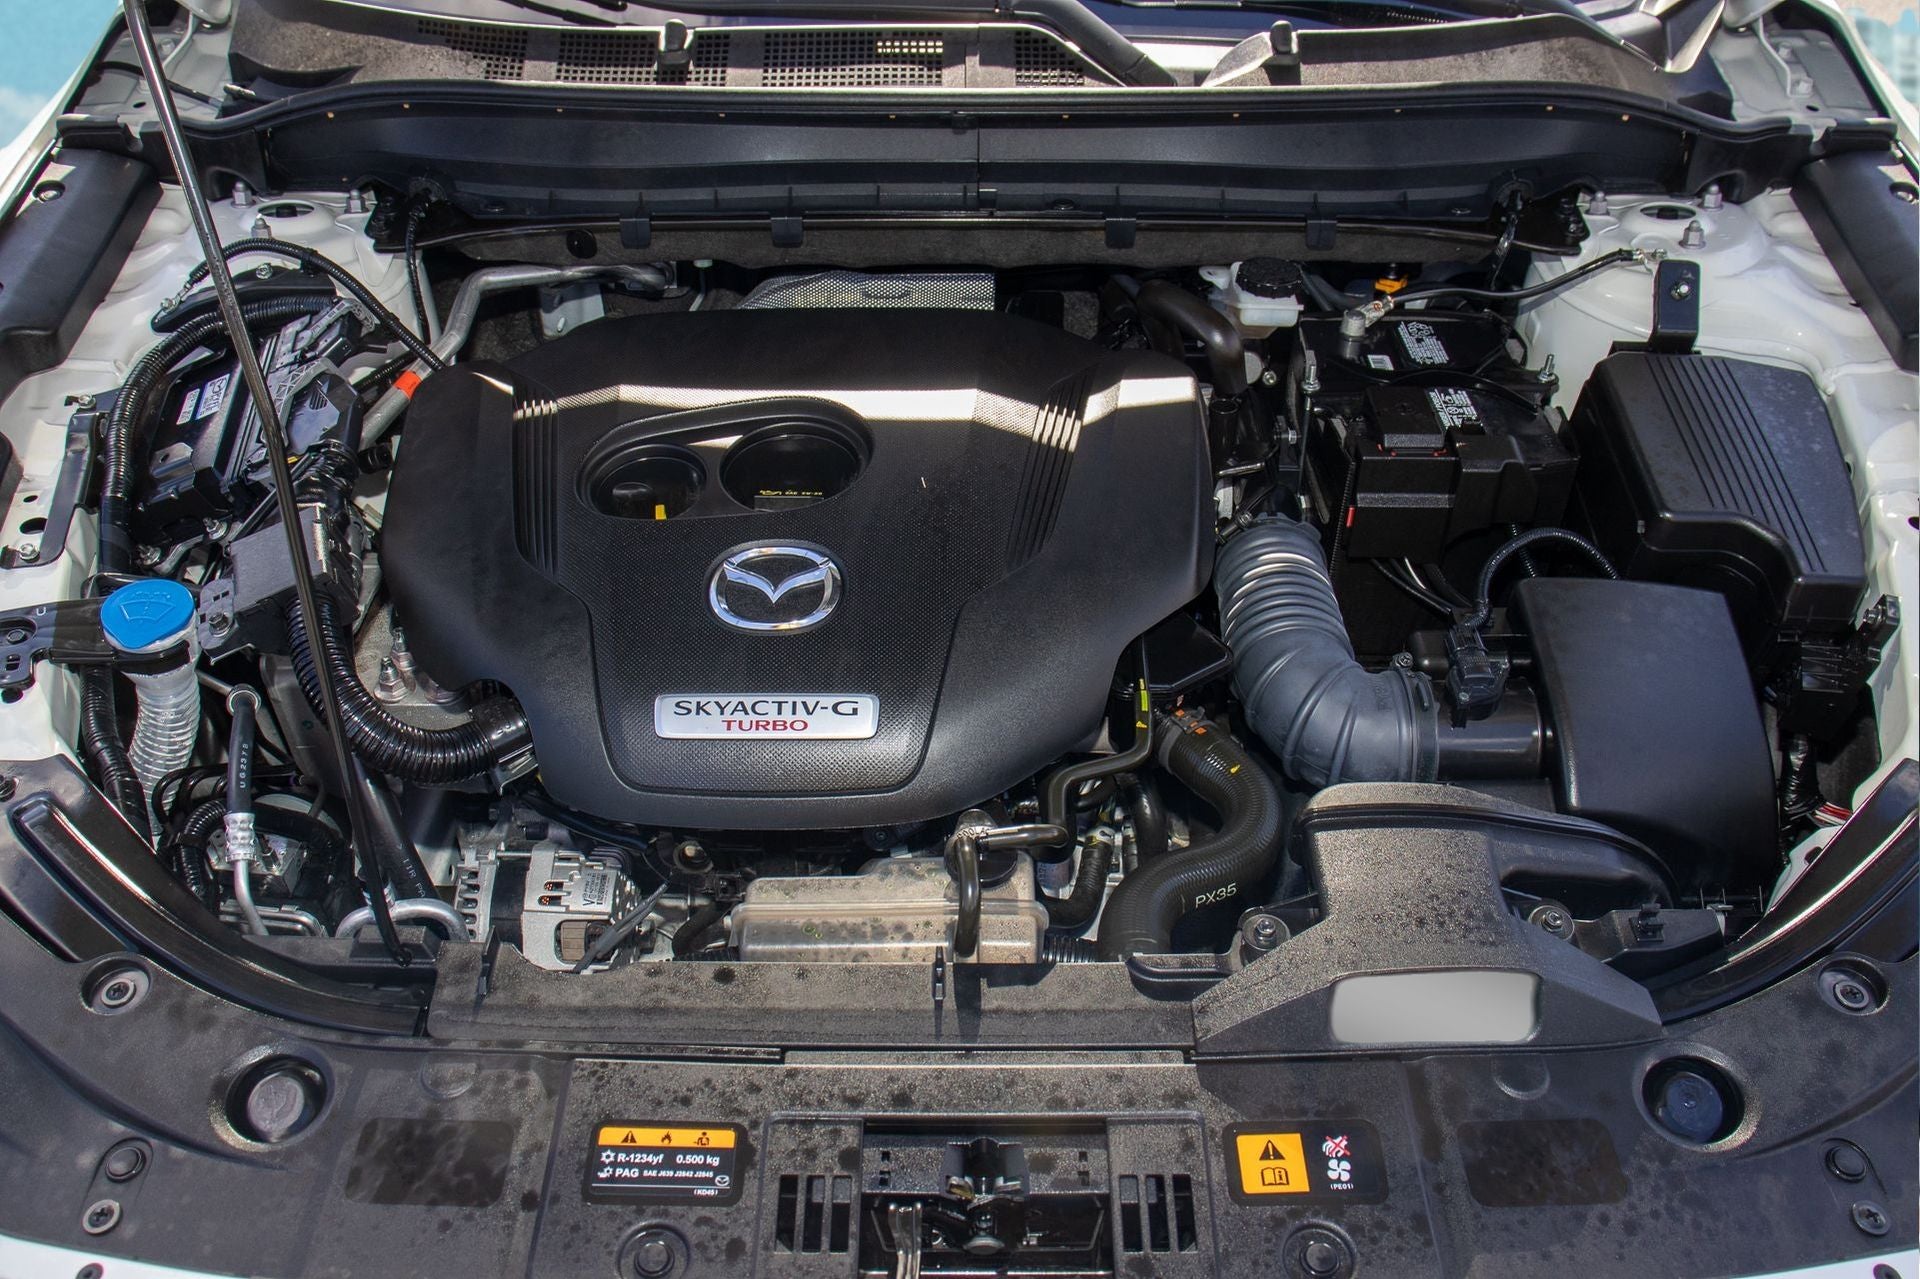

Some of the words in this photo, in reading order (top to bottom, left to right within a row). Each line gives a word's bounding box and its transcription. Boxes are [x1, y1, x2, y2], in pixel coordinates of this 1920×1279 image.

[673, 700, 859, 716] SKYACTIV-G
[721, 719, 809, 732] TURBO
[1195, 882, 1237, 909] PX35
[617, 1153, 664, 1166] R-1234yf
[676, 1155, 705, 1164] 0.500
[706, 1154, 720, 1166] kg
[614, 1168, 639, 1178] PAG
